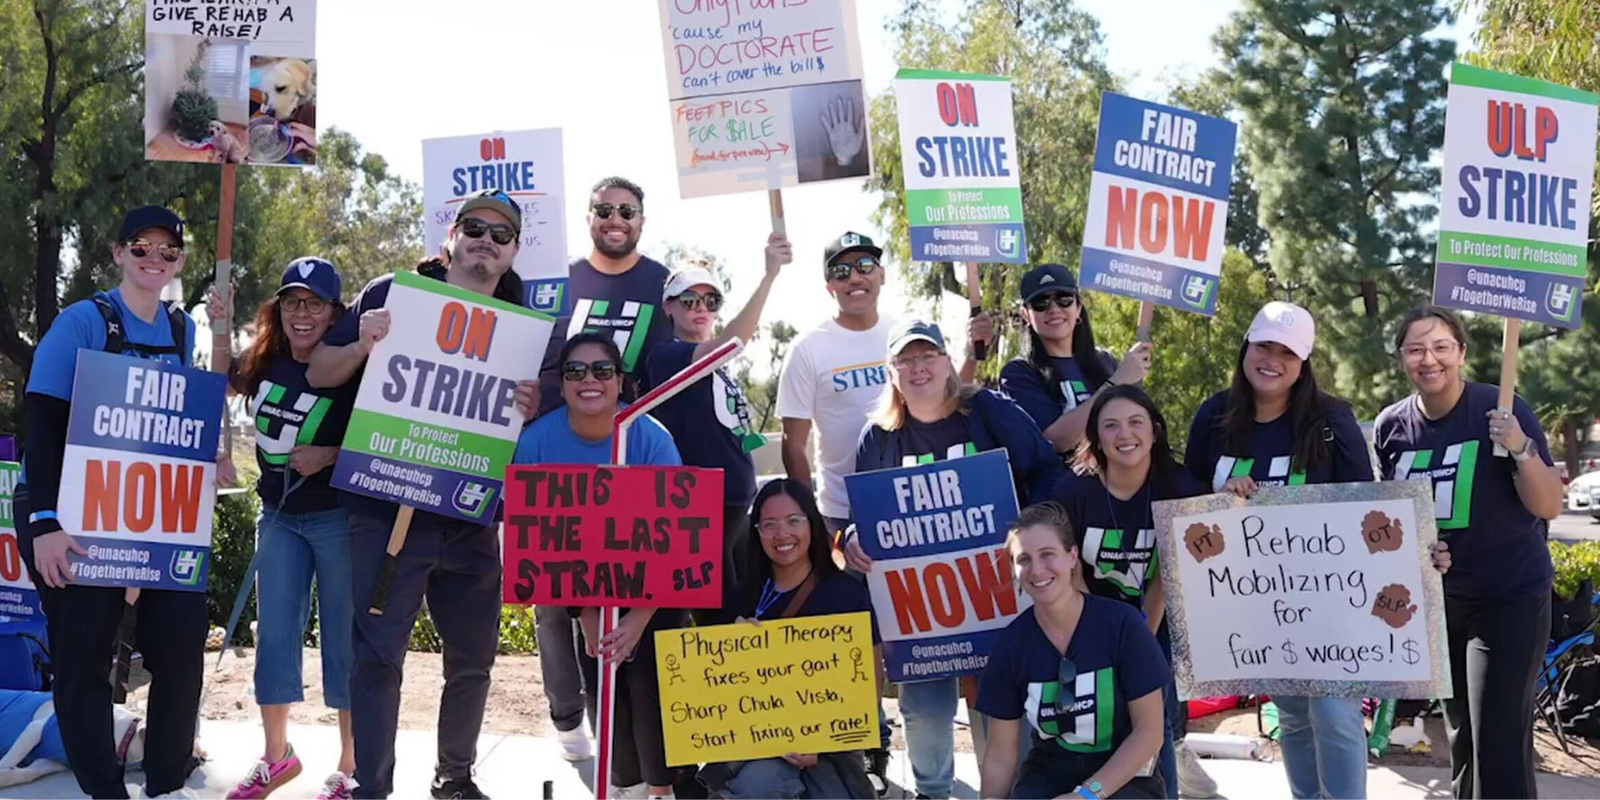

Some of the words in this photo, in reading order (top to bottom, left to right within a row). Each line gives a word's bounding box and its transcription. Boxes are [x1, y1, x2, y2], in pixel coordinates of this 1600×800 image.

[153, 6, 198, 21] GIVE
[206, 7, 268, 23] REHAB
[279, 6, 293, 22] A
[192, 21, 261, 39] RAISE!
[738, 19, 763, 39] my
[673, 27, 834, 75] DOCTORATE
[683, 71, 724, 88] can't
[727, 66, 759, 82] cover
[763, 63, 782, 77] the
[676, 103, 715, 122] FEET
[719, 99, 768, 118] PICS
[936, 82, 979, 127] ON
[688, 124, 719, 142] FOR
[1141, 108, 1198, 151] FAIR
[1487, 99, 1558, 163] ULP
[480, 137, 506, 162] ON
[915, 136, 1010, 178] STRIKE
[1114, 139, 1216, 187] CONTRACT
[453, 161, 535, 197] STRIKE
[948, 191, 956, 202] To
[957, 191, 984, 202] Protect
[925, 205, 945, 222] Our
[948, 203, 1010, 221] Professions
[1458, 165, 1577, 230] STRIKE
[1105, 185, 1215, 262] NOW
[924, 243, 990, 257] #TogetherWeRise
[1450, 238, 1462, 254] To
[1463, 241, 1503, 259] Protect
[1504, 245, 1522, 260] Our
[1523, 246, 1578, 267] Professions
[1094, 272, 1173, 300] #TogetherWeRise
[1109, 259, 1162, 282] @unacuhcp
[1467, 268, 1526, 293] @unacuhcp
[1451, 285, 1537, 314] #TogetherWeRise
[436, 301, 498, 363] ON
[125, 366, 187, 412] FAIR
[382, 354, 517, 427] STRIKE
[93, 405, 204, 449] CONTRACT
[409, 423, 420, 437] To
[421, 426, 459, 445] Protect
[369, 431, 396, 453] Our
[399, 436, 490, 473] Professions
[349, 471, 442, 507] #TogetherWeRise
[370, 458, 433, 487] @unacuhcp
[515, 469, 613, 508] THIS
[655, 470, 697, 510] IS
[82, 459, 204, 533] NOW
[893, 469, 963, 514] FAIR
[509, 514, 582, 552] THE
[604, 517, 710, 554] LAST
[876, 504, 996, 550] CONTRACT
[1193, 532, 1212, 553] PT
[1241, 515, 1346, 557] Rehab
[1368, 524, 1391, 543] OT
[70, 562, 161, 583] #TogetherWeRise
[88, 545, 150, 565] @unacuhcp
[1100, 551, 1151, 560] UNACUHCP
[514, 558, 653, 602] STRAW.
[672, 561, 714, 591] SLP
[884, 549, 1018, 636] NOW
[1208, 564, 1367, 609] Mobilizing
[1273, 599, 1311, 626] for
[1377, 595, 1405, 613] SLP
[680, 629, 769, 666] Physical
[778, 624, 853, 645] Therapy
[911, 641, 973, 659] @unacuhcp
[1228, 633, 1272, 669] fair
[1283, 637, 1298, 665] $
[1306, 633, 1394, 674] wages!
[1402, 637, 1420, 665] $
[704, 667, 750, 688] fixes
[756, 663, 795, 686] your
[801, 652, 840, 677] gait
[670, 701, 728, 724] Sharp
[739, 695, 785, 714] Chula
[796, 688, 844, 706] Vista,
[750, 724, 795, 744] fixing
[800, 724, 822, 737] our
[830, 713, 869, 733] rate!
